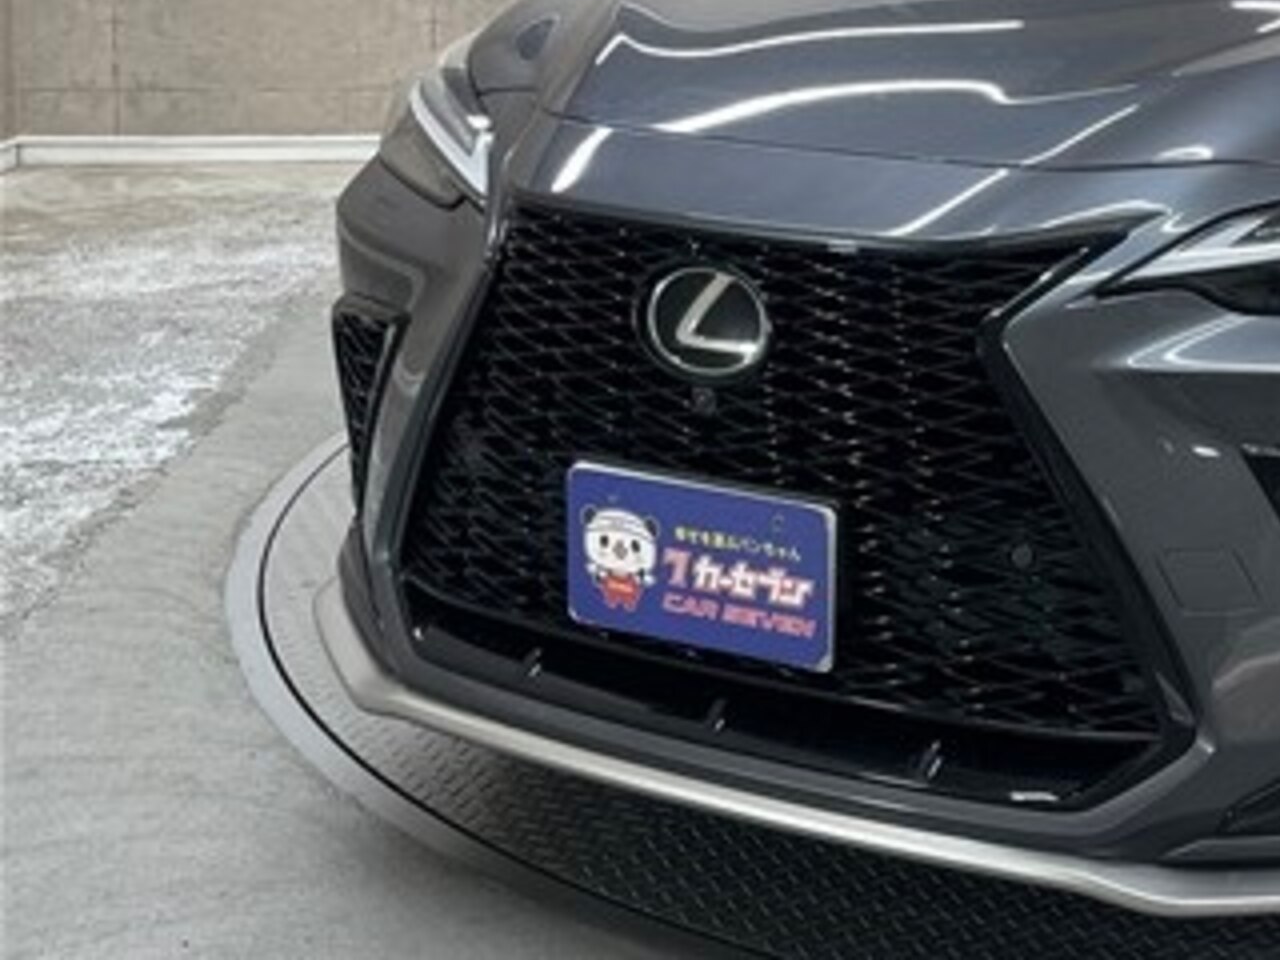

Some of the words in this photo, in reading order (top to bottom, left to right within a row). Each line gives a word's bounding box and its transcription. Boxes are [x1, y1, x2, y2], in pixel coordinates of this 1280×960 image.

[692, 554, 816, 608] カーセブン
[661, 592, 720, 622] CAR
